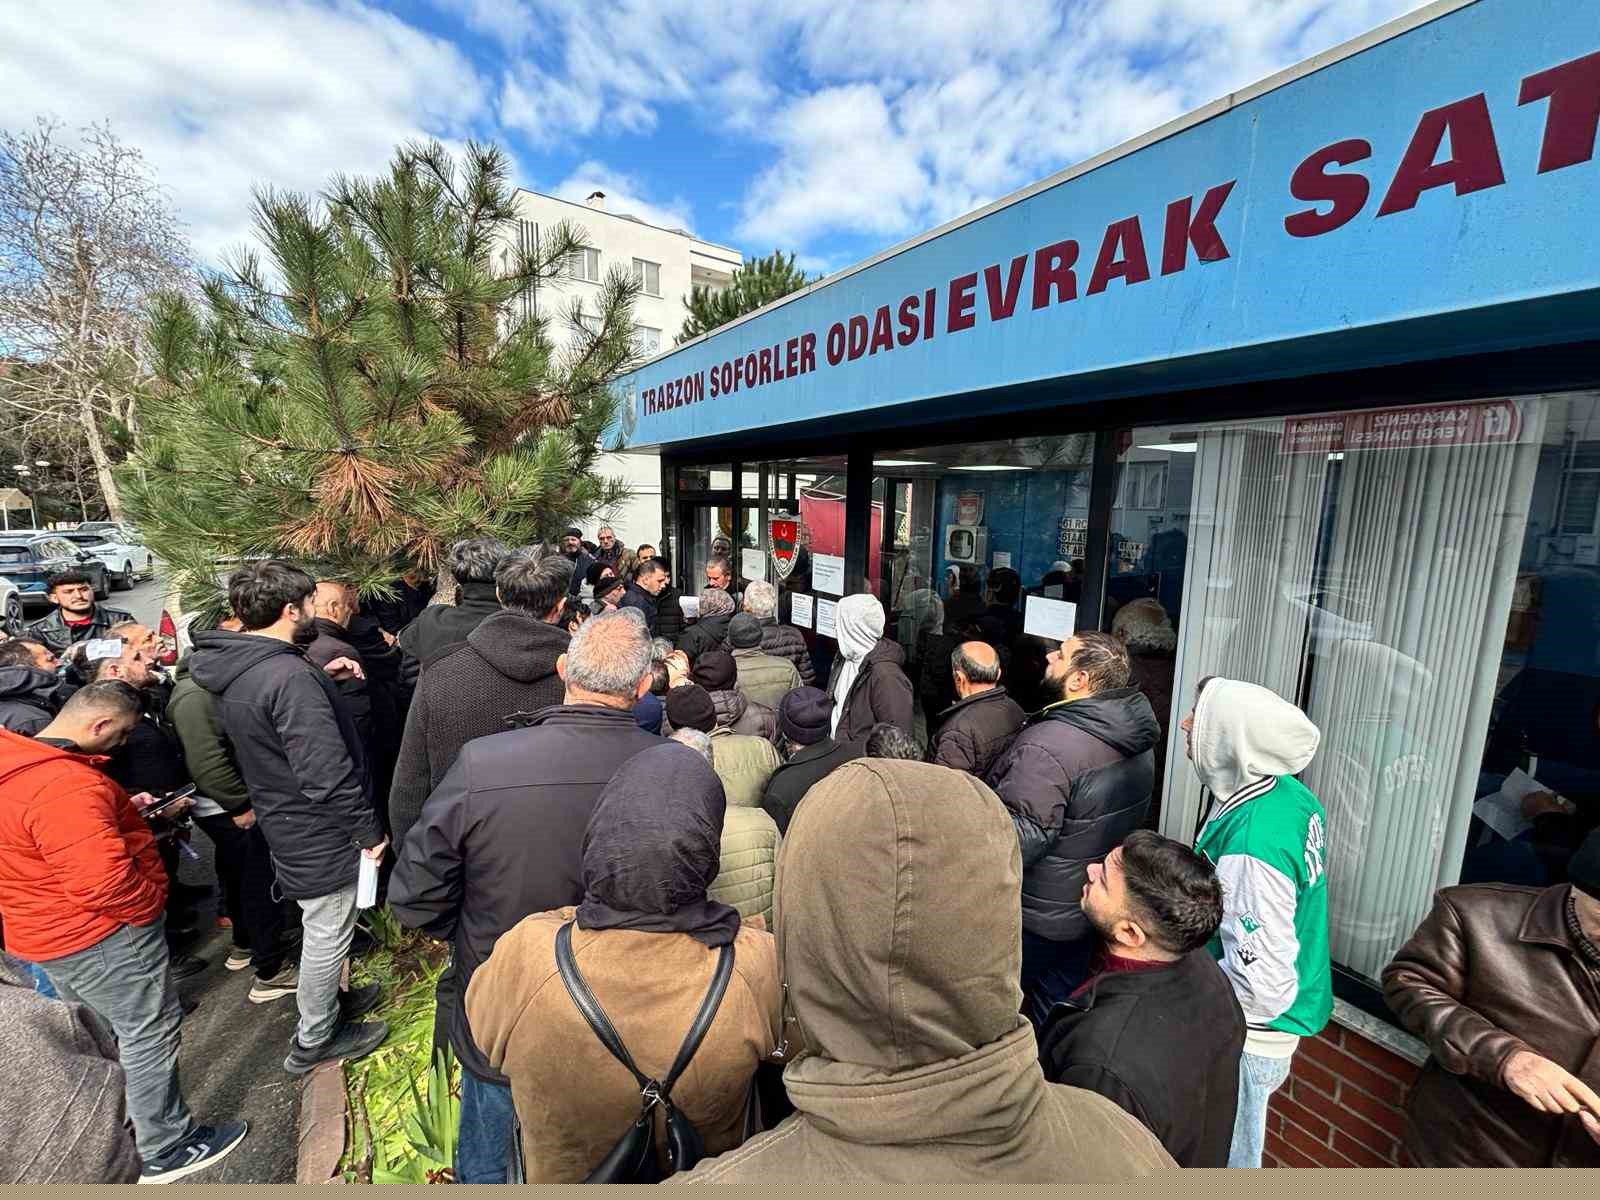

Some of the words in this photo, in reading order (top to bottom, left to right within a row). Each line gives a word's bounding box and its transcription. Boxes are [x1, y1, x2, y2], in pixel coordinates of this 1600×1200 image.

[641, 370, 705, 417] TRABZON
[827, 289, 935, 367] ODASI
[947, 179, 1238, 333] EVRAK
[1284, 52, 1600, 237] SAT
